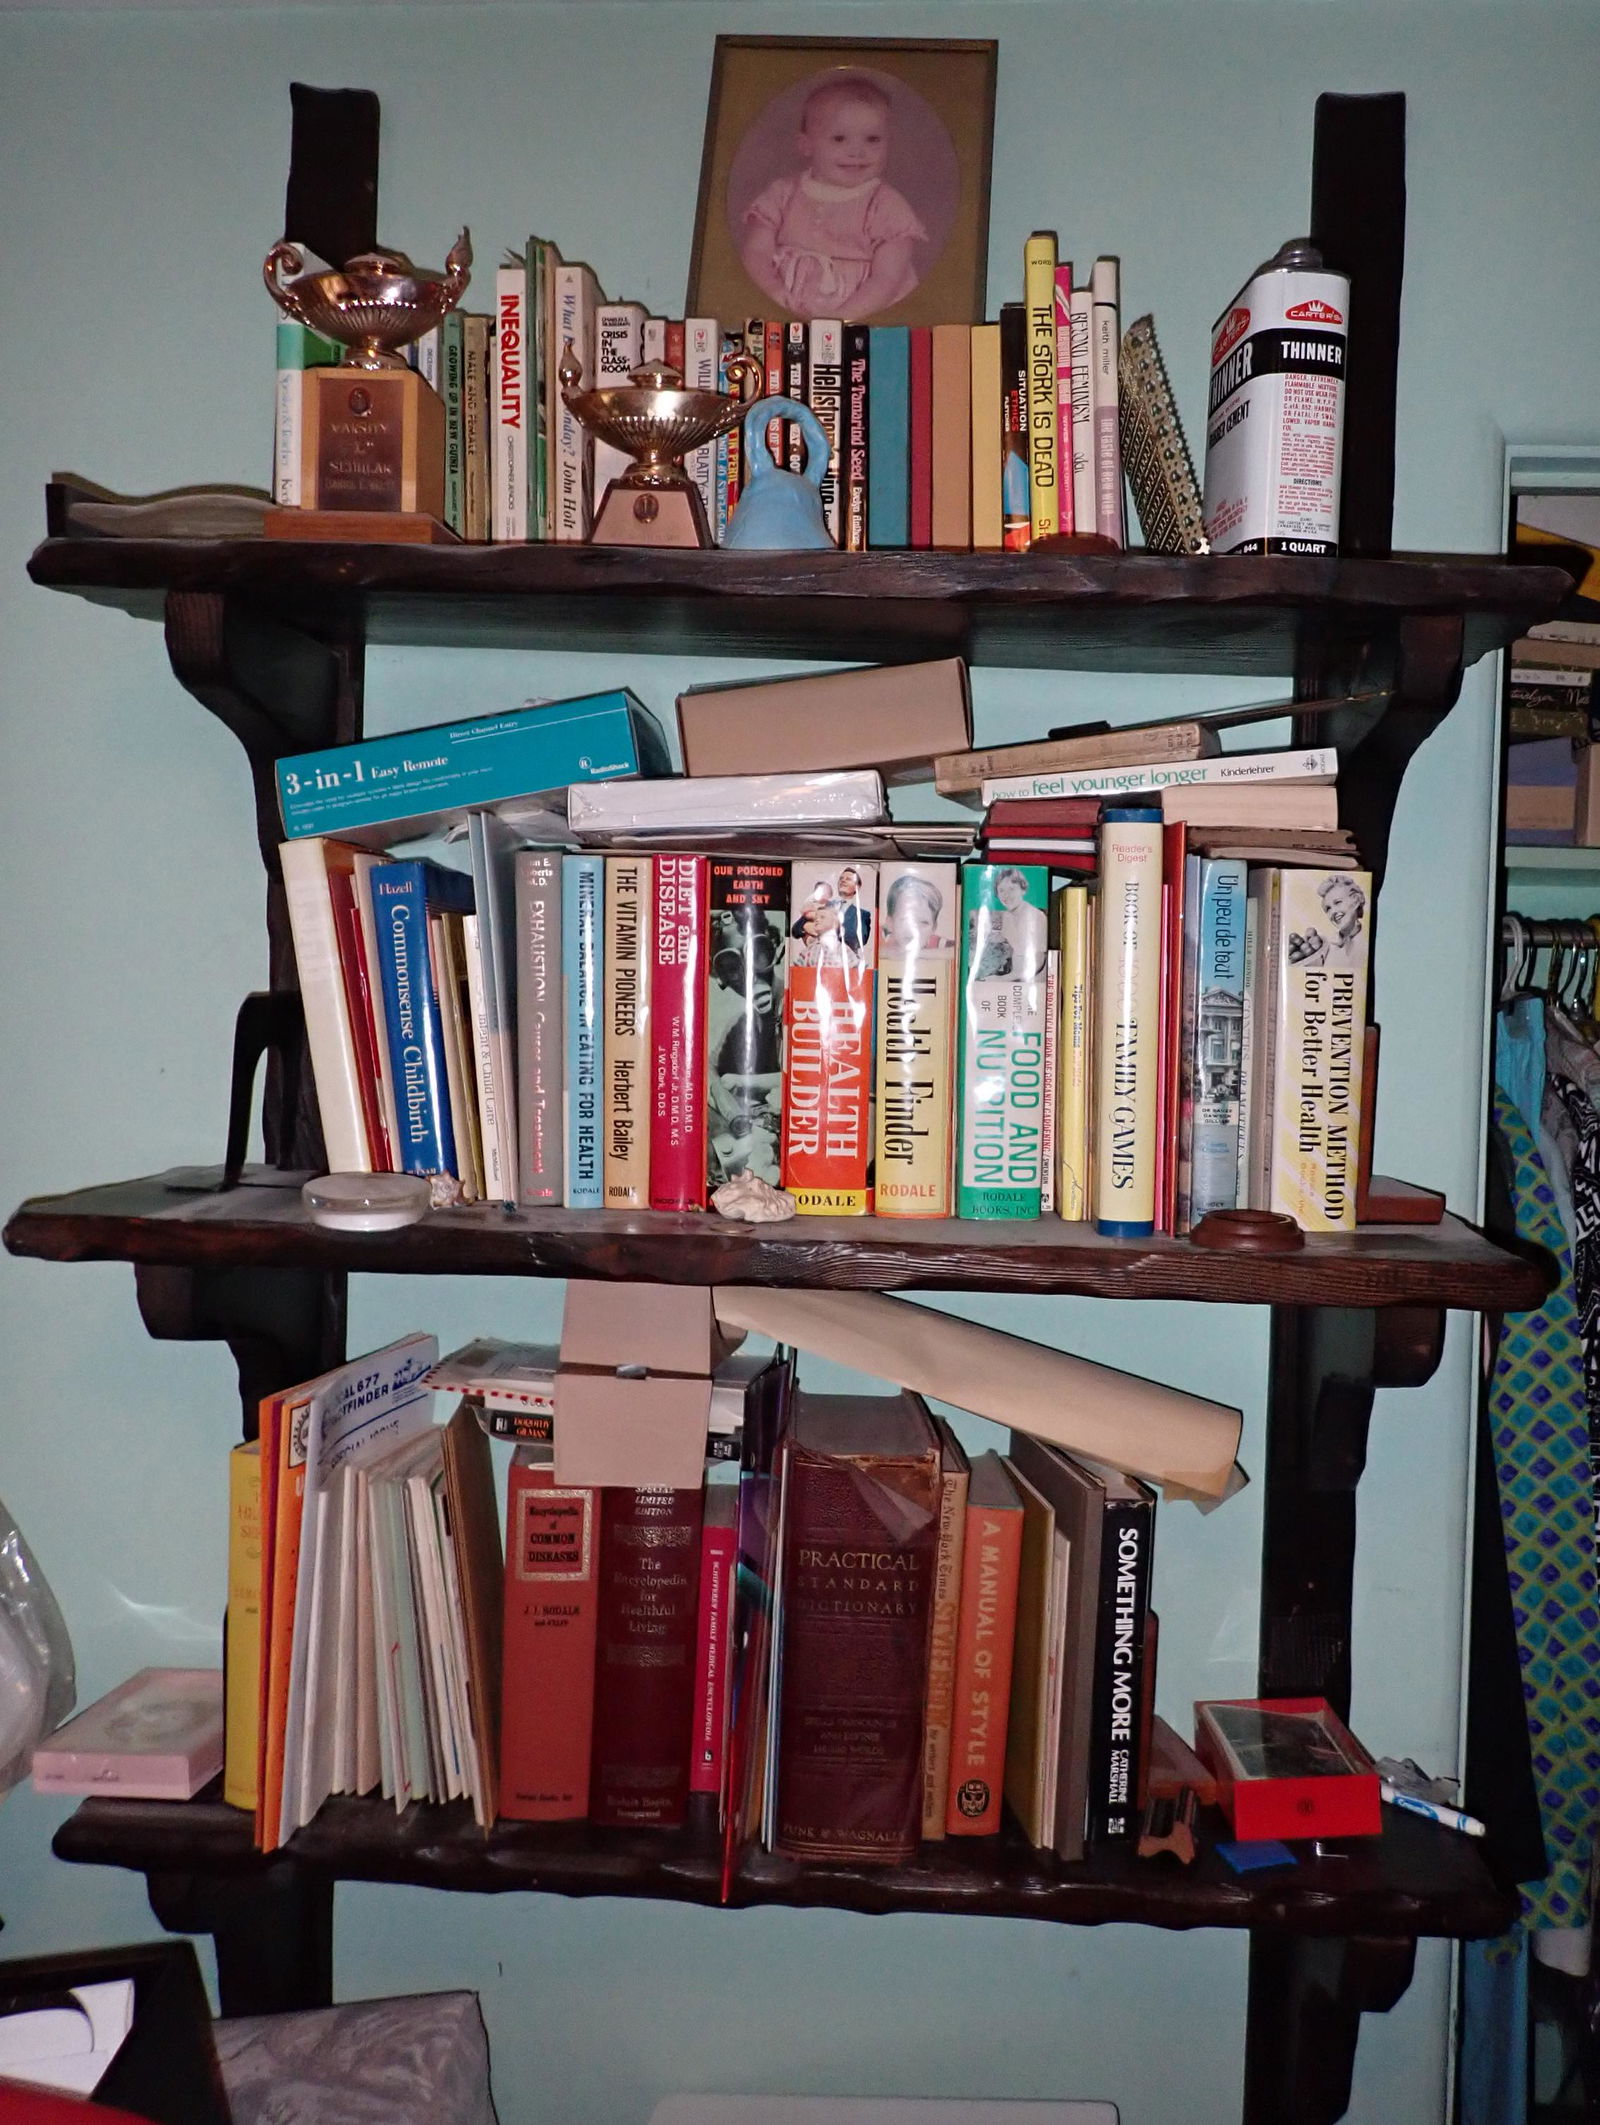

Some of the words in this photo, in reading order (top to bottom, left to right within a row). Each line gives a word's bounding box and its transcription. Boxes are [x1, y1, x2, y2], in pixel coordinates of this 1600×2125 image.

[563, 294, 576, 331] What
[1033, 305, 1053, 337] THE
[1290, 310, 1339, 322] CARTER'S
[601, 330, 628, 339] CRISIS
[1070, 312, 1089, 358] BEYOND
[1101, 319, 1111, 344] keith
[448, 345, 458, 389] GROWING
[468, 351, 477, 381] MALE
[500, 295, 521, 429] INEQUALITY
[600, 357, 631, 365] CLASS-
[601, 349, 618, 357] THE
[1101, 348, 1112, 375] miller
[1281, 341, 1342, 365] THINNER
[601, 365, 631, 373] ROOM
[790, 362, 802, 386] THE
[850, 358, 866, 383] The
[1034, 344, 1053, 404] STORK
[448, 392, 458, 405] UP
[468, 385, 477, 410] AND
[1018, 370, 1027, 432] SITUATION
[1072, 365, 1090, 425] FEMINISM
[448, 408, 458, 417] IN
[850, 385, 866, 446] Tamarind
[1011, 389, 1019, 432] ETHICS
[1226, 400, 1251, 433] CEMENT
[448, 420, 458, 439] NEW
[468, 414, 477, 456] FEMALE
[448, 443, 459, 475] GUINEA
[1101, 436, 1114, 458] taste
[695, 446, 710, 488] BLATTY
[850, 449, 865, 481] Seed
[1035, 437, 1055, 488] DEAD
[1101, 459, 1115, 471] of
[562, 461, 577, 494] John
[1102, 472, 1114, 491] new
[1293, 478, 1323, 487] DIRECTIONS
[563, 498, 578, 529] Holt
[850, 486, 863, 513] Evelyn
[1102, 493, 1115, 516] wine
[1281, 541, 1288, 551] 1
[1289, 542, 1327, 554] QUART
[450, 725, 471, 739] Direct
[471, 724, 499, 735] Channel
[499, 720, 519, 731] Entry
[371, 765, 401, 780] Easy
[403, 755, 450, 773] Remote
[590, 761, 631, 774] RadioShack
[1220, 765, 1275, 778] Kinderlehrer
[1018, 788, 1030, 798] to
[1032, 777, 1065, 797] feel
[1070, 773, 1147, 793] younger
[1151, 767, 1208, 785] longer
[1111, 843, 1153, 854] Reader's
[1117, 853, 1148, 864] Digest
[616, 867, 638, 894] THE
[713, 865, 734, 876] OUR
[737, 865, 784, 878] POISONED
[732, 880, 764, 891] EARTH
[1213, 874, 1240, 895] Un
[678, 859, 697, 918] DIET
[725, 894, 748, 905] AND
[751, 894, 771, 905] SKY
[578, 871, 594, 937] MINERAL
[658, 859, 676, 965] DISEASE
[1211, 898, 1232, 926] peu
[615, 901, 638, 961] VITAMIN
[677, 925, 698, 965] and
[1214, 929, 1237, 948] de
[529, 900, 546, 1003] EXHAUSTION
[1214, 951, 1236, 980] tout
[1047, 975, 1055, 991] THE
[1072, 984, 1084, 1004] Tips
[1304, 971, 1328, 1003] for
[614, 968, 637, 1036] PIONEERS
[981, 1000, 991, 1013] OF
[997, 994, 1007, 1019] BOOK
[1073, 1005, 1083, 1020] For
[390, 904, 415, 1040] Commonsense
[403, 1045, 429, 1144] Childbirth
[886, 976, 939, 1064] Health
[1073, 1022, 1083, 1049] Moms
[1301, 1009, 1327, 1078] Better
[1328, 972, 1354, 1115] PREVENTION
[480, 1050, 490, 1061] &
[579, 1034, 595, 1085] EATING
[670, 1040, 681, 1080] Ringsdorf
[1114, 1020, 1139, 1104] FAMILY
[482, 1062, 495, 1094] Child
[788, 999, 824, 1157] BUILDER
[824, 998, 863, 1160] HEALTH
[1011, 1031, 1042, 1109] FOOD
[613, 1059, 635, 1113] Herbert
[485, 1097, 497, 1126] Care
[579, 1091, 595, 1119] FOR
[973, 1028, 1006, 1184] NUTRITION
[1298, 1084, 1325, 1154] Health
[884, 1080, 935, 1166] Finder
[578, 1125, 595, 1179] HEALTH
[611, 1119, 635, 1161] Bailey
[1008, 1121, 1039, 1184] AND
[1108, 1106, 1136, 1190] GAMES
[1042, 1158, 1050, 1185] SWENSON
[1323, 1124, 1349, 1221] METHOD
[879, 1183, 937, 1199] RODALE
[982, 1191, 1027, 1202] RODALE
[357, 1372, 380, 1391] 677
[635, 1495, 675, 1505] LIMITED
[944, 1479, 957, 1503] The
[941, 1505, 956, 1531] New
[982, 1520, 1000, 1539] A
[530, 1532, 576, 1545] COMMON
[940, 1533, 954, 1561] York
[528, 1550, 579, 1563] DISEASES
[639, 1557, 662, 1571] The
[799, 1549, 920, 1571] PRACTICAL
[613, 1571, 688, 1588] Encyclopedia
[797, 1576, 919, 1593] STANDARD
[938, 1563, 953, 1600] Times
[975, 1544, 999, 1641] MANUAL
[640, 1590, 657, 1604] for
[798, 1599, 918, 1616] DICTIONARY
[1113, 1527, 1139, 1664] SOMETHING
[542, 1604, 581, 1616] RODALE
[620, 1603, 677, 1617] Healthful
[628, 1620, 667, 1636] Living
[710, 1611, 719, 1642] FAMILY
[707, 1642, 717, 1679] MEDICAL
[972, 1650, 992, 1679] OF
[704, 1680, 714, 1742] ENCYCLOPEDIA
[1110, 1670, 1133, 1740] MORE
[967, 1690, 989, 1767] STYLE
[1108, 1748, 1121, 1804] MARSHALL
[1116, 1748, 1130, 1803] CATHERINE
